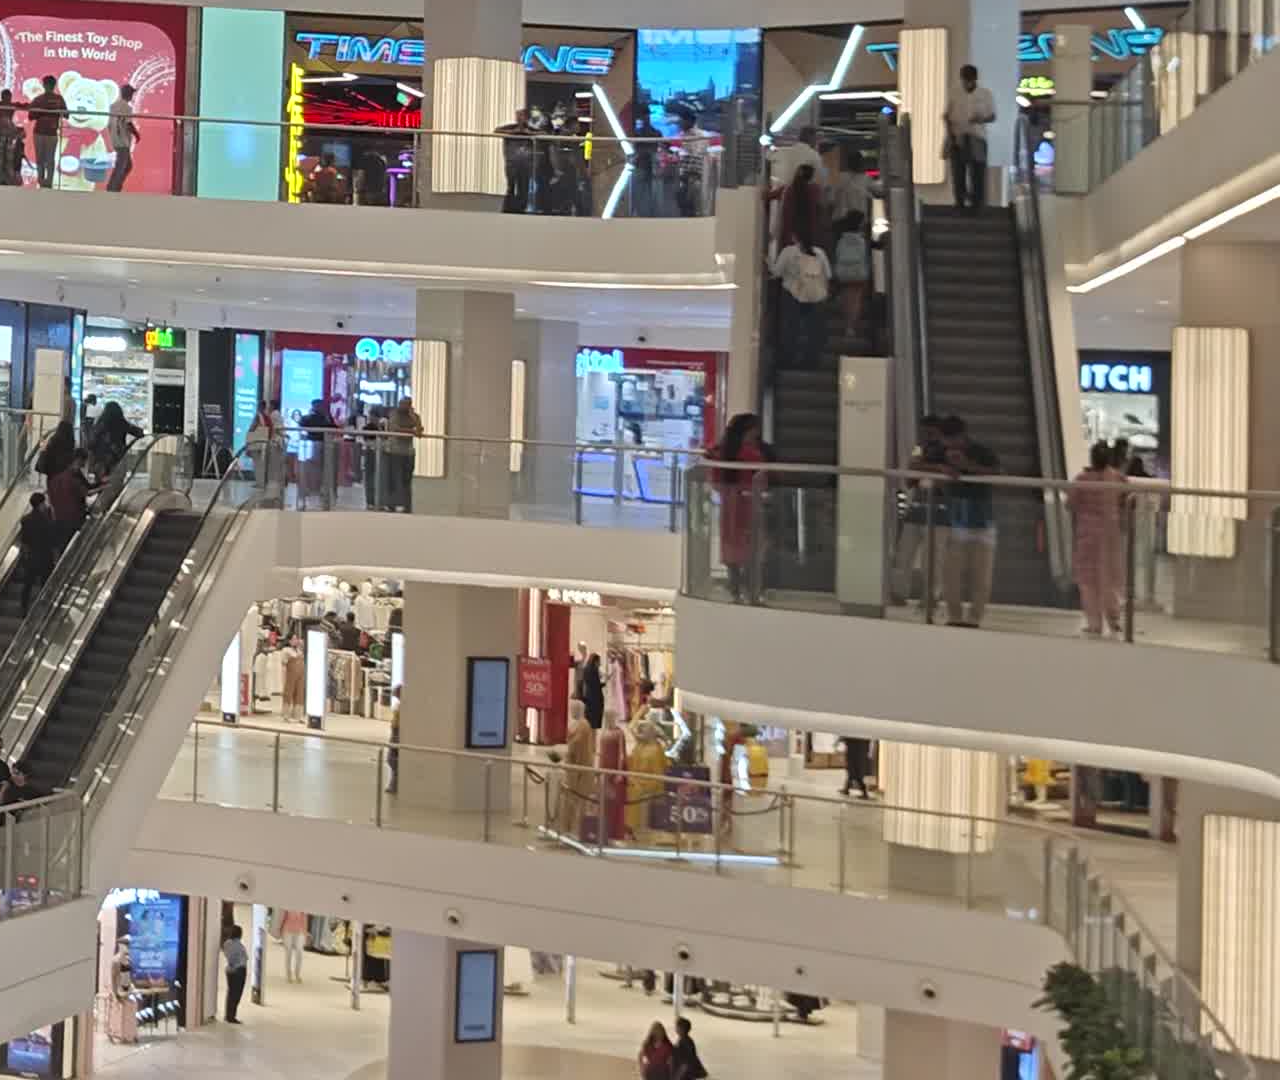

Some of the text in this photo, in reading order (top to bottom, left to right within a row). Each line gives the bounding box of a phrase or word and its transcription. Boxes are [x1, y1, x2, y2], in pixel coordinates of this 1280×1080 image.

[18, 30, 144, 51] The Finest Toy Shop
[58, 46, 80, 59] the
[80, 47, 117, 62] World
[1080, 363, 1153, 392] ITCH
